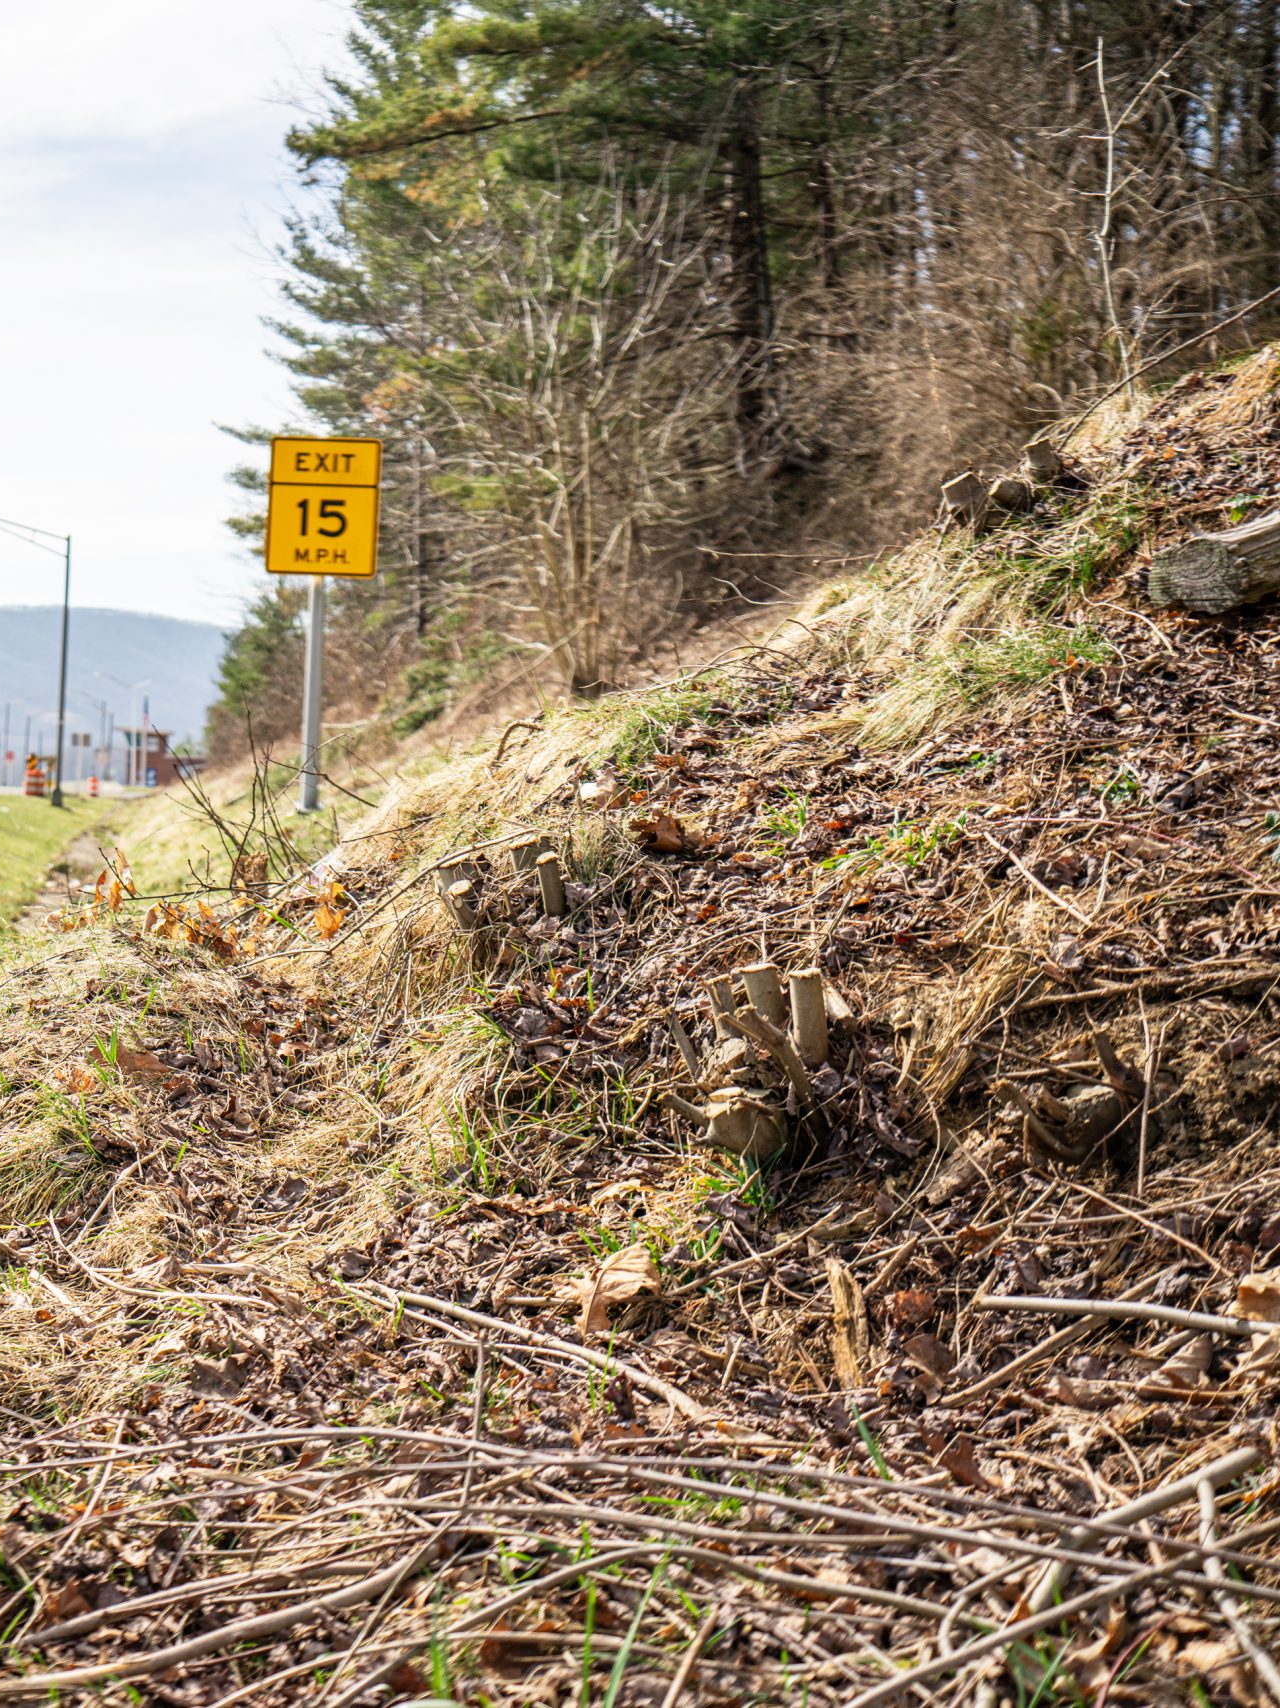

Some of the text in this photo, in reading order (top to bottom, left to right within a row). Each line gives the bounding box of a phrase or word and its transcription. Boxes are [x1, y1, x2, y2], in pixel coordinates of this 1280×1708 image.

[295, 452, 356, 473] EXIT
[297, 498, 348, 538] 15
[295, 548, 351, 564] M.P.H.
